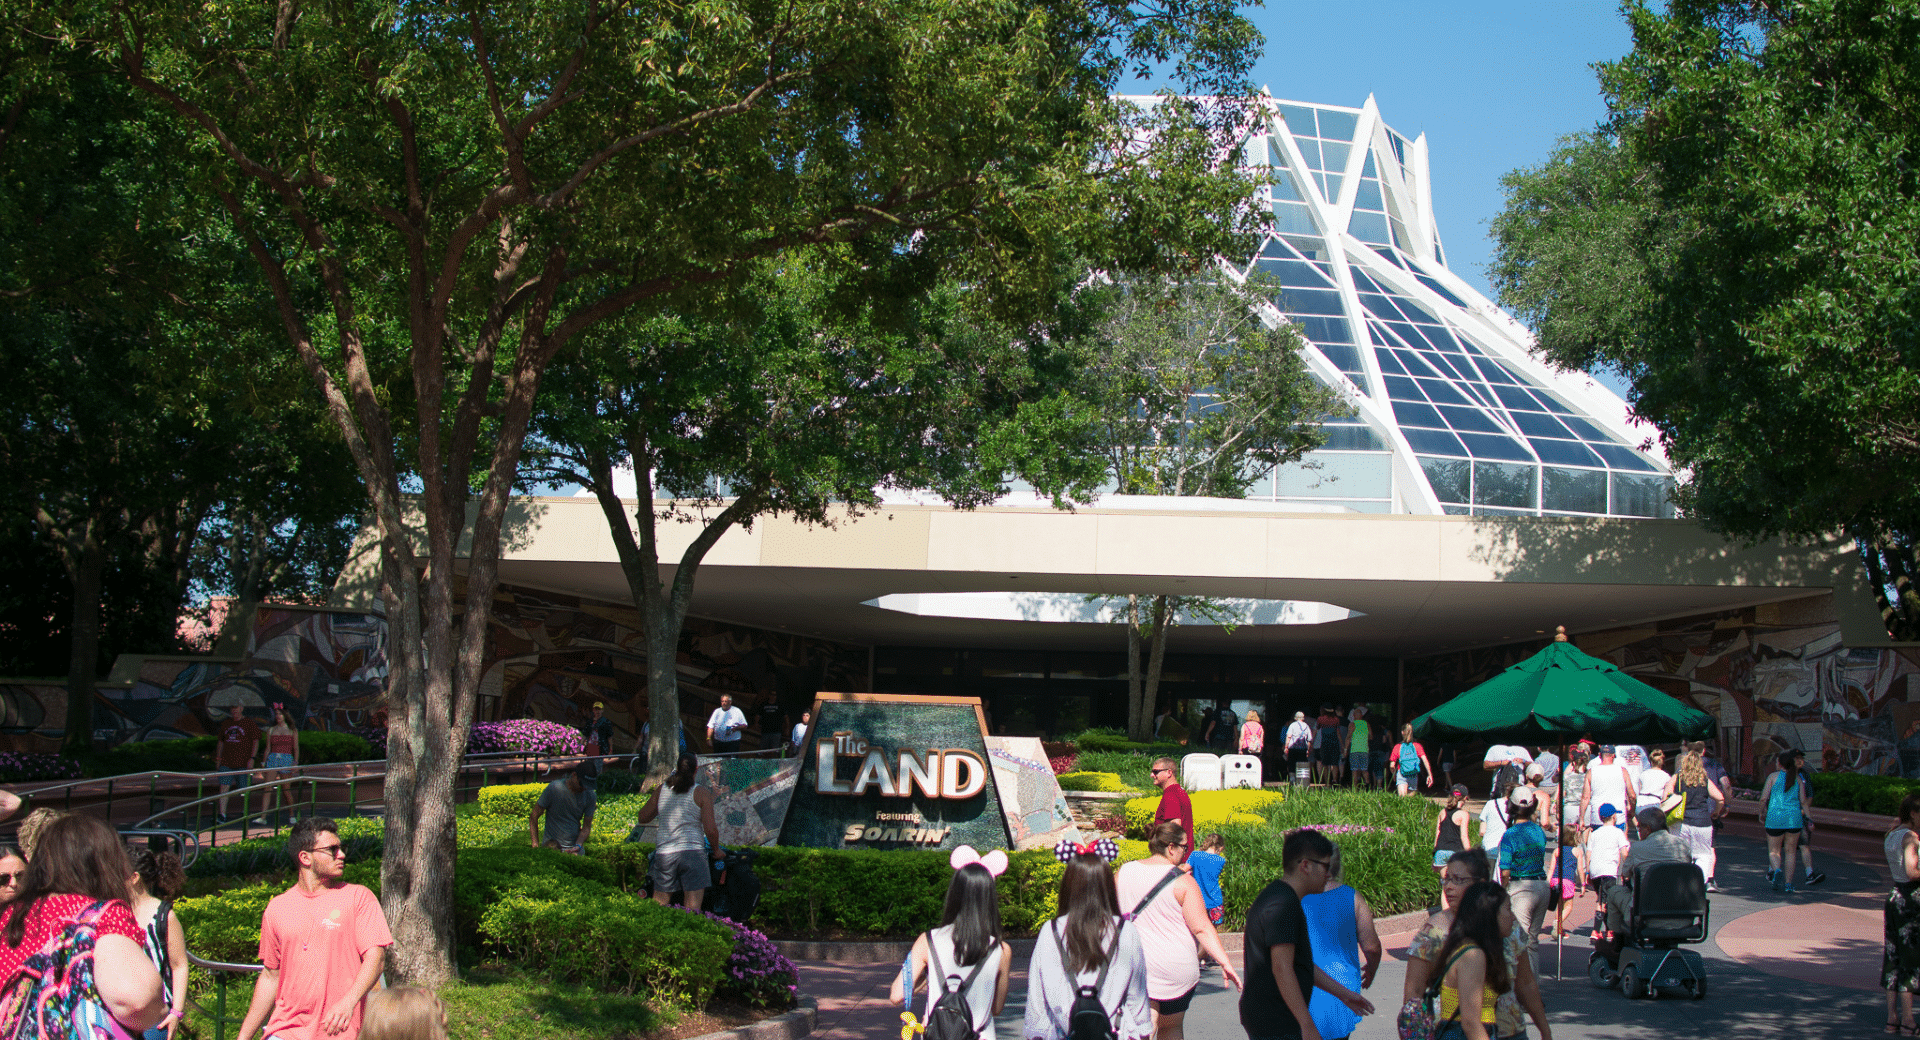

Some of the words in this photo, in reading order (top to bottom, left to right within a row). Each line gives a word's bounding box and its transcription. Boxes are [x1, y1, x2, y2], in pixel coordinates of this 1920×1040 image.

[835, 734, 868, 755] The
[817, 738, 987, 798] LAND
[876, 810, 920, 824] Featuring
